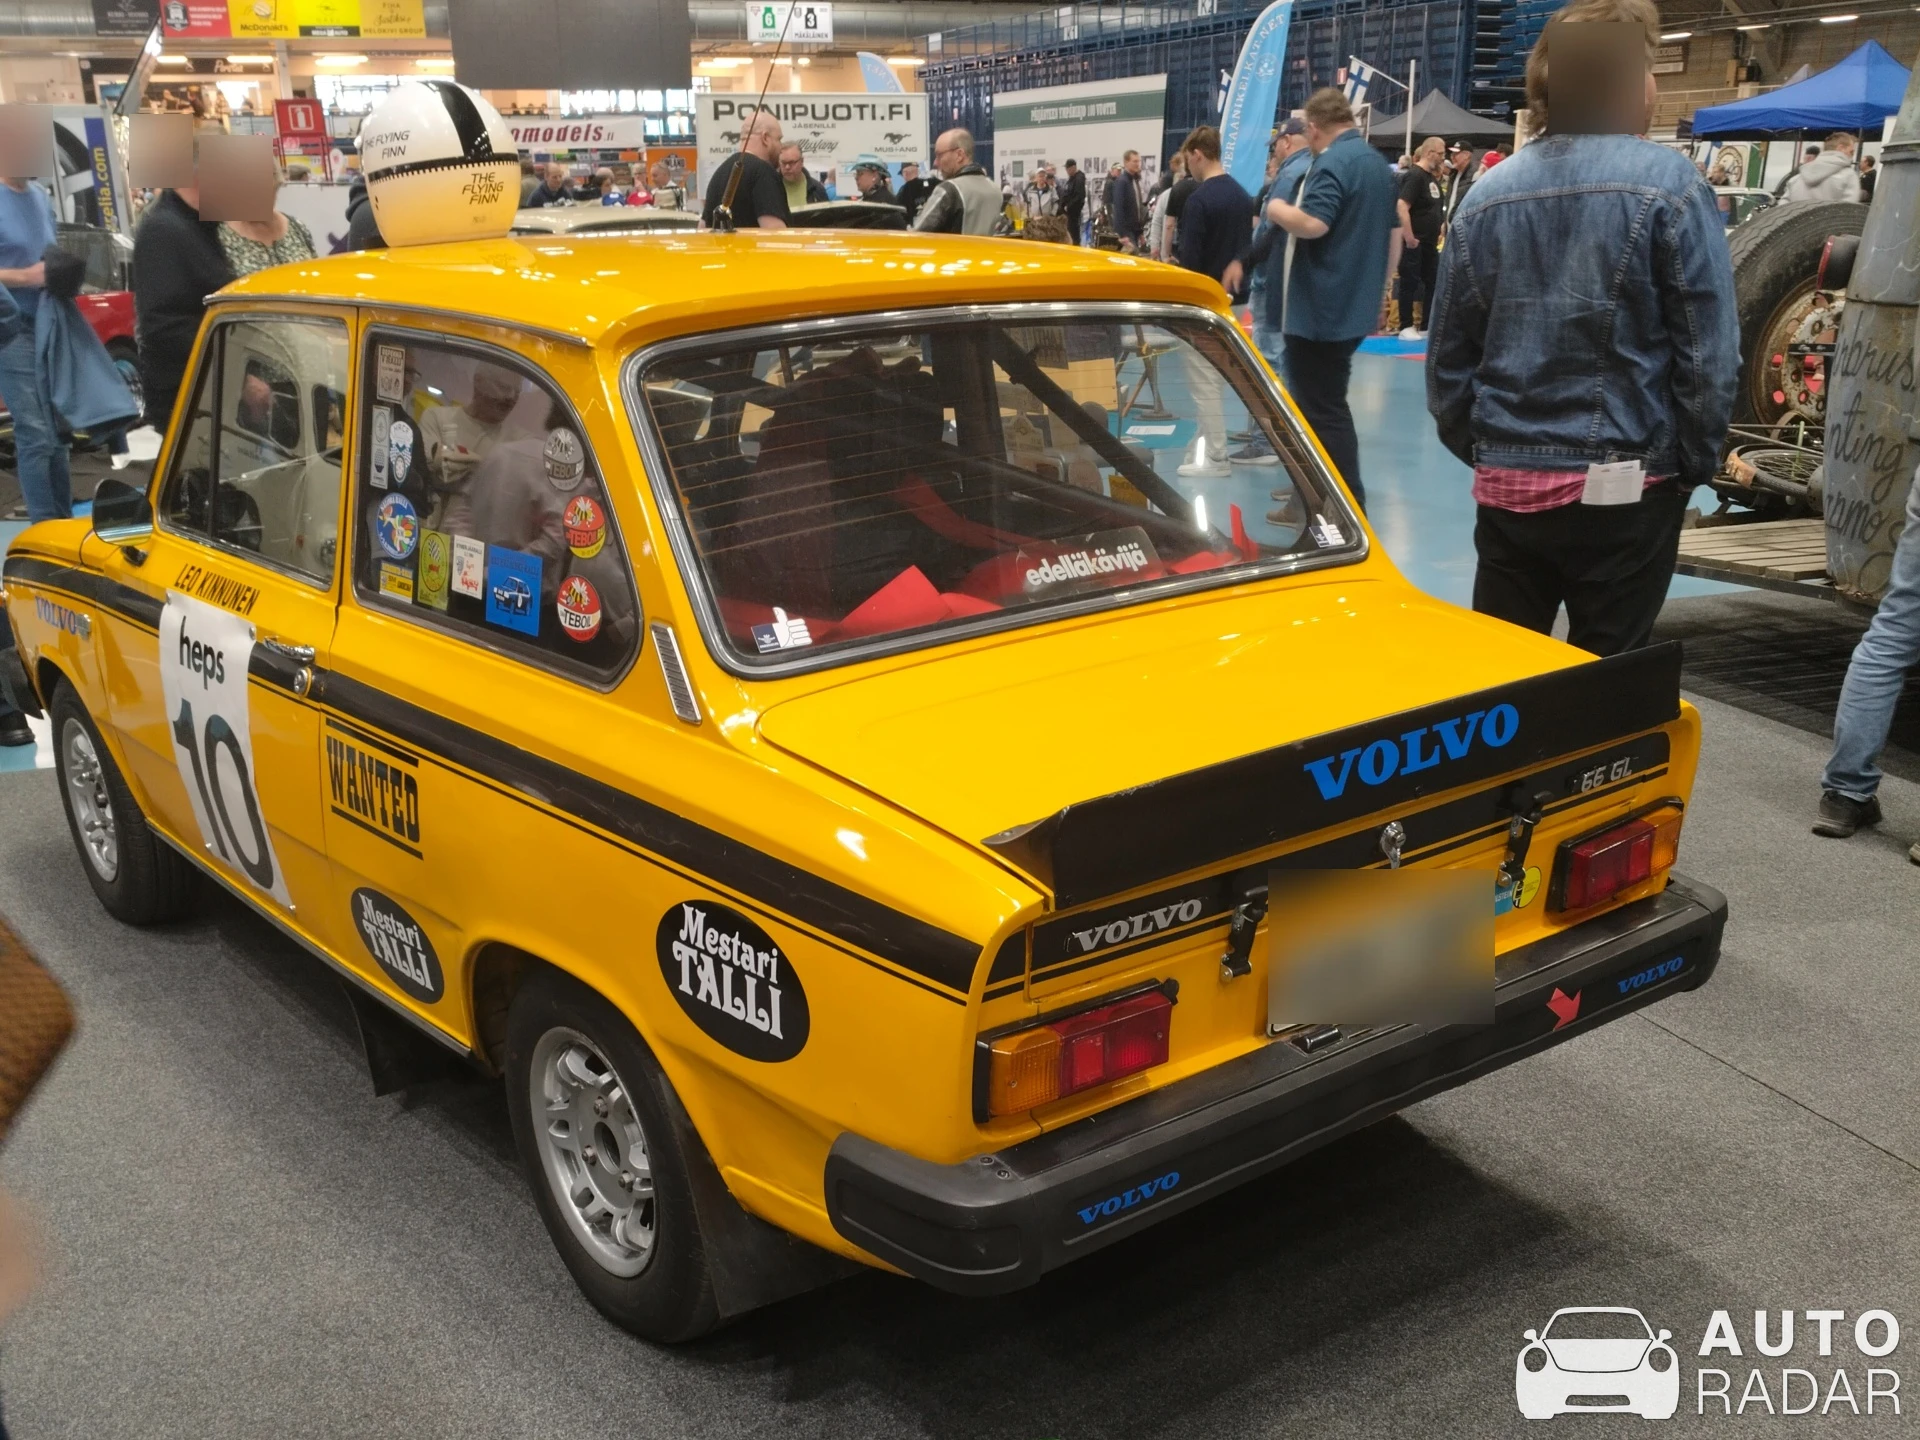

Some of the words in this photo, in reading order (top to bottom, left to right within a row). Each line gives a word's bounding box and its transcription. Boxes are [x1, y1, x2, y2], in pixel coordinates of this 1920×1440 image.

[240, 24, 288, 32] McDonald's
[765, 12, 775, 27] 6
[806, 13, 815, 27] 3
[713, 100, 911, 121] PONIPUOTI.FI
[1223, 13, 1285, 174] TERAANIKELKAT.NET
[375, 130, 410, 147] FLYING
[381, 145, 406, 160] FINN
[511, 123, 615, 143] omodels.fi
[462, 182, 504, 195] FLYING
[471, 172, 496, 184] THE
[469, 193, 499, 205] FINN
[1026, 542, 1148, 586] edelläkävijä
[174, 563, 201, 591] LEO
[195, 569, 260, 616] KINNUNEN
[34, 596, 76, 635] VOLVO
[179, 615, 225, 690] heps
[1303, 702, 1520, 801] VOLVO
[172, 697, 274, 890] 10
[326, 734, 420, 844] WANTED
[1581, 765, 1607, 793] 66
[1610, 756, 1633, 781] GL
[358, 892, 422, 951] Mestari
[1072, 898, 1202, 952] VOLVO
[363, 919, 434, 992] TALLI
[679, 902, 779, 985] Mestari
[672, 940, 784, 1040] TALLI
[1617, 956, 1683, 995] VOLVO
[1077, 1170, 1181, 1226] VOLVO
